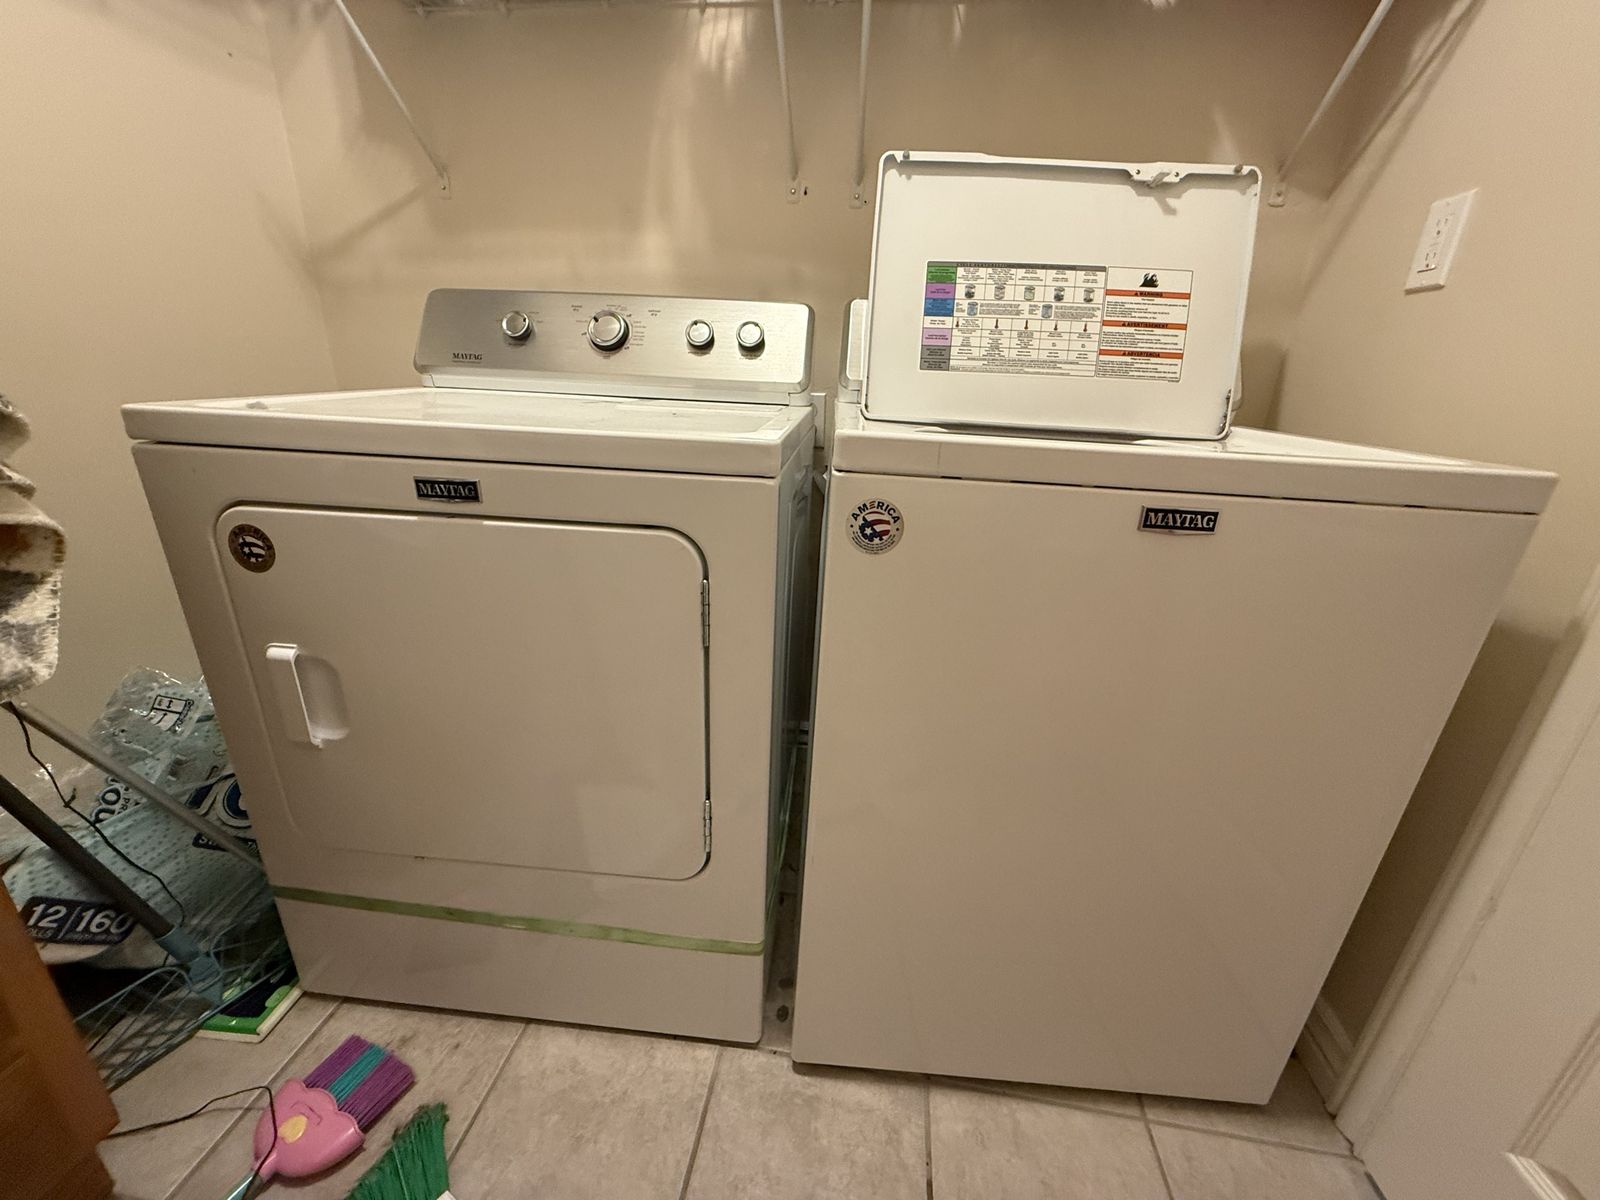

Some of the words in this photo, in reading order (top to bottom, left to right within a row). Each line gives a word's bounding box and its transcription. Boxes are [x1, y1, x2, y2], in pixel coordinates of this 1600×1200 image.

[452, 352, 482, 360] MAYTAG
[418, 482, 475, 496] MAYTAG
[851, 500, 901, 524] AMERICA
[1146, 511, 1215, 528] MAYTAG
